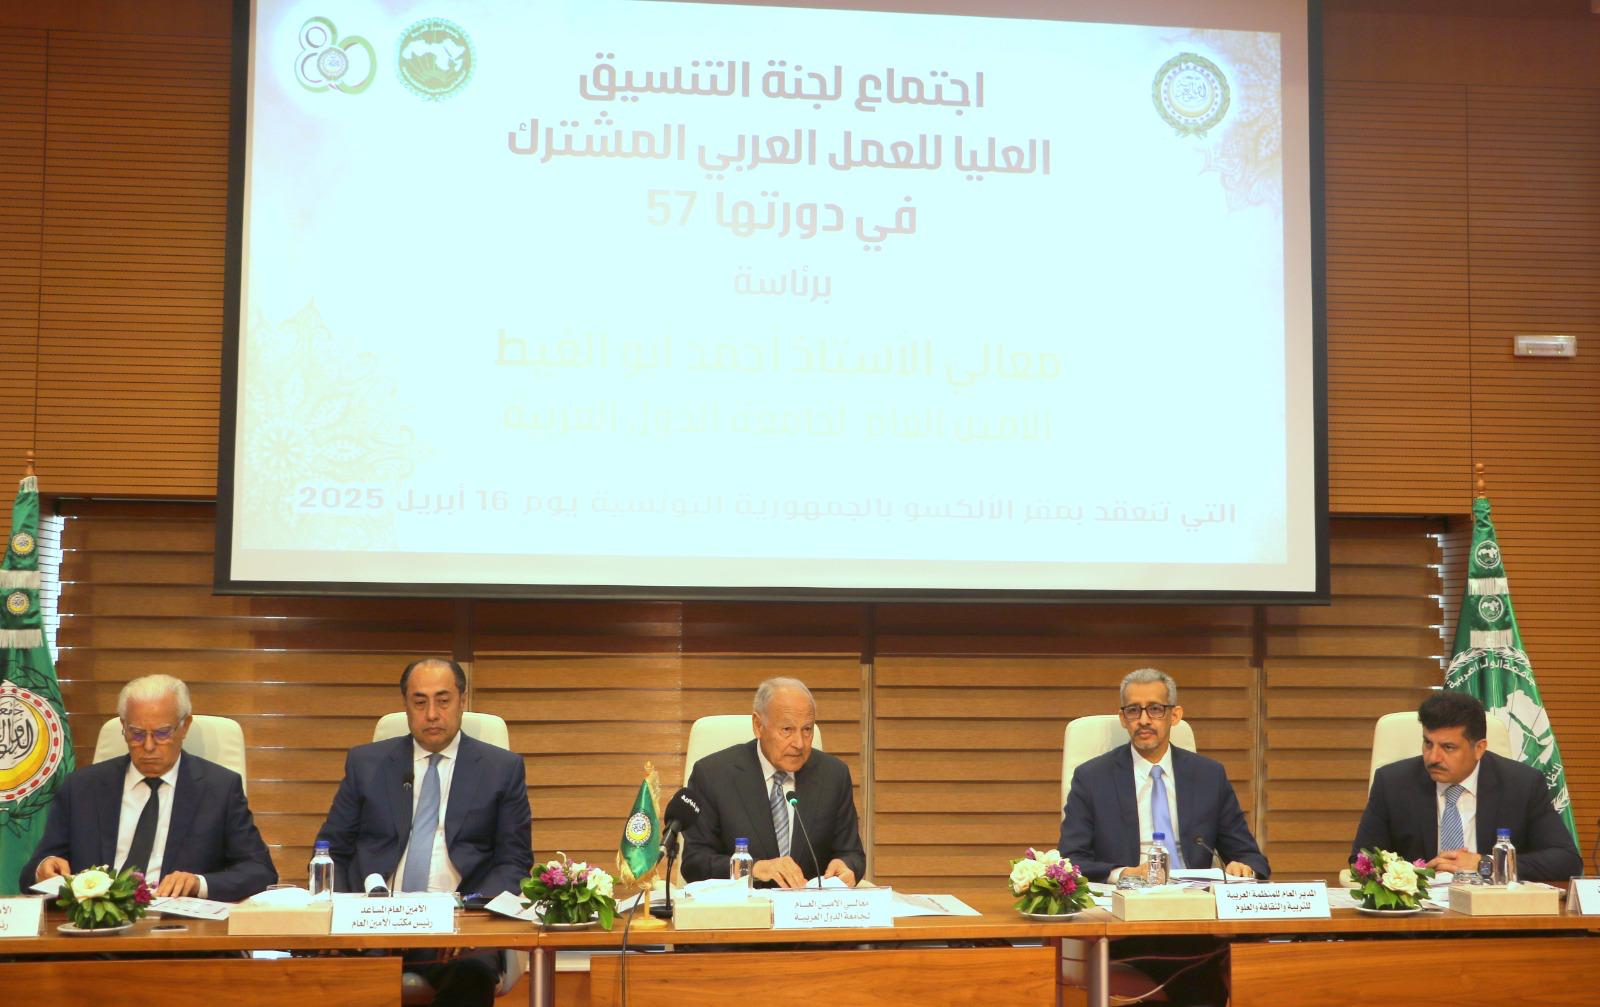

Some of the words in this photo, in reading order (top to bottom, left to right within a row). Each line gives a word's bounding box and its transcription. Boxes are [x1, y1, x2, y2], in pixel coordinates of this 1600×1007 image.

[579, 51, 750, 104] التنسيق
[761, 59, 843, 110] لجنة
[854, 67, 985, 116] اجتماع
[507, 110, 686, 164] المشترك
[828, 130, 943, 171] للعمل
[698, 129, 817, 181] العربي
[954, 136, 1051, 181] العليا
[647, 189, 698, 226] 57
[716, 190, 845, 240] دورتها
[855, 195, 917, 252] في
[734, 265, 832, 304] برئاسة
[494, 326, 609, 384] الغيط
[943, 338, 1062, 398] معالي
[299, 486, 385, 510] 2025
[397, 484, 465, 516] أبريل
[476, 489, 509, 512] 16
[523, 495, 578, 518] يوم
[592, 490, 724, 519] التونسية
[735, 493, 892, 522] بالجمهورية
[1023, 498, 1084, 525] بمقر
[1093, 499, 1169, 523] تنعقد
[1181, 501, 1236, 532] التي
[1226, 890, 1250, 900] العربية
[1251, 890, 1280, 898] للمنظمة
[1282, 890, 1296, 898] العام
[351, 919, 368, 929] العام
[387, 905, 404, 915] العام
[392, 918, 412, 930] مكتب
[413, 918, 433, 929] رئيس
